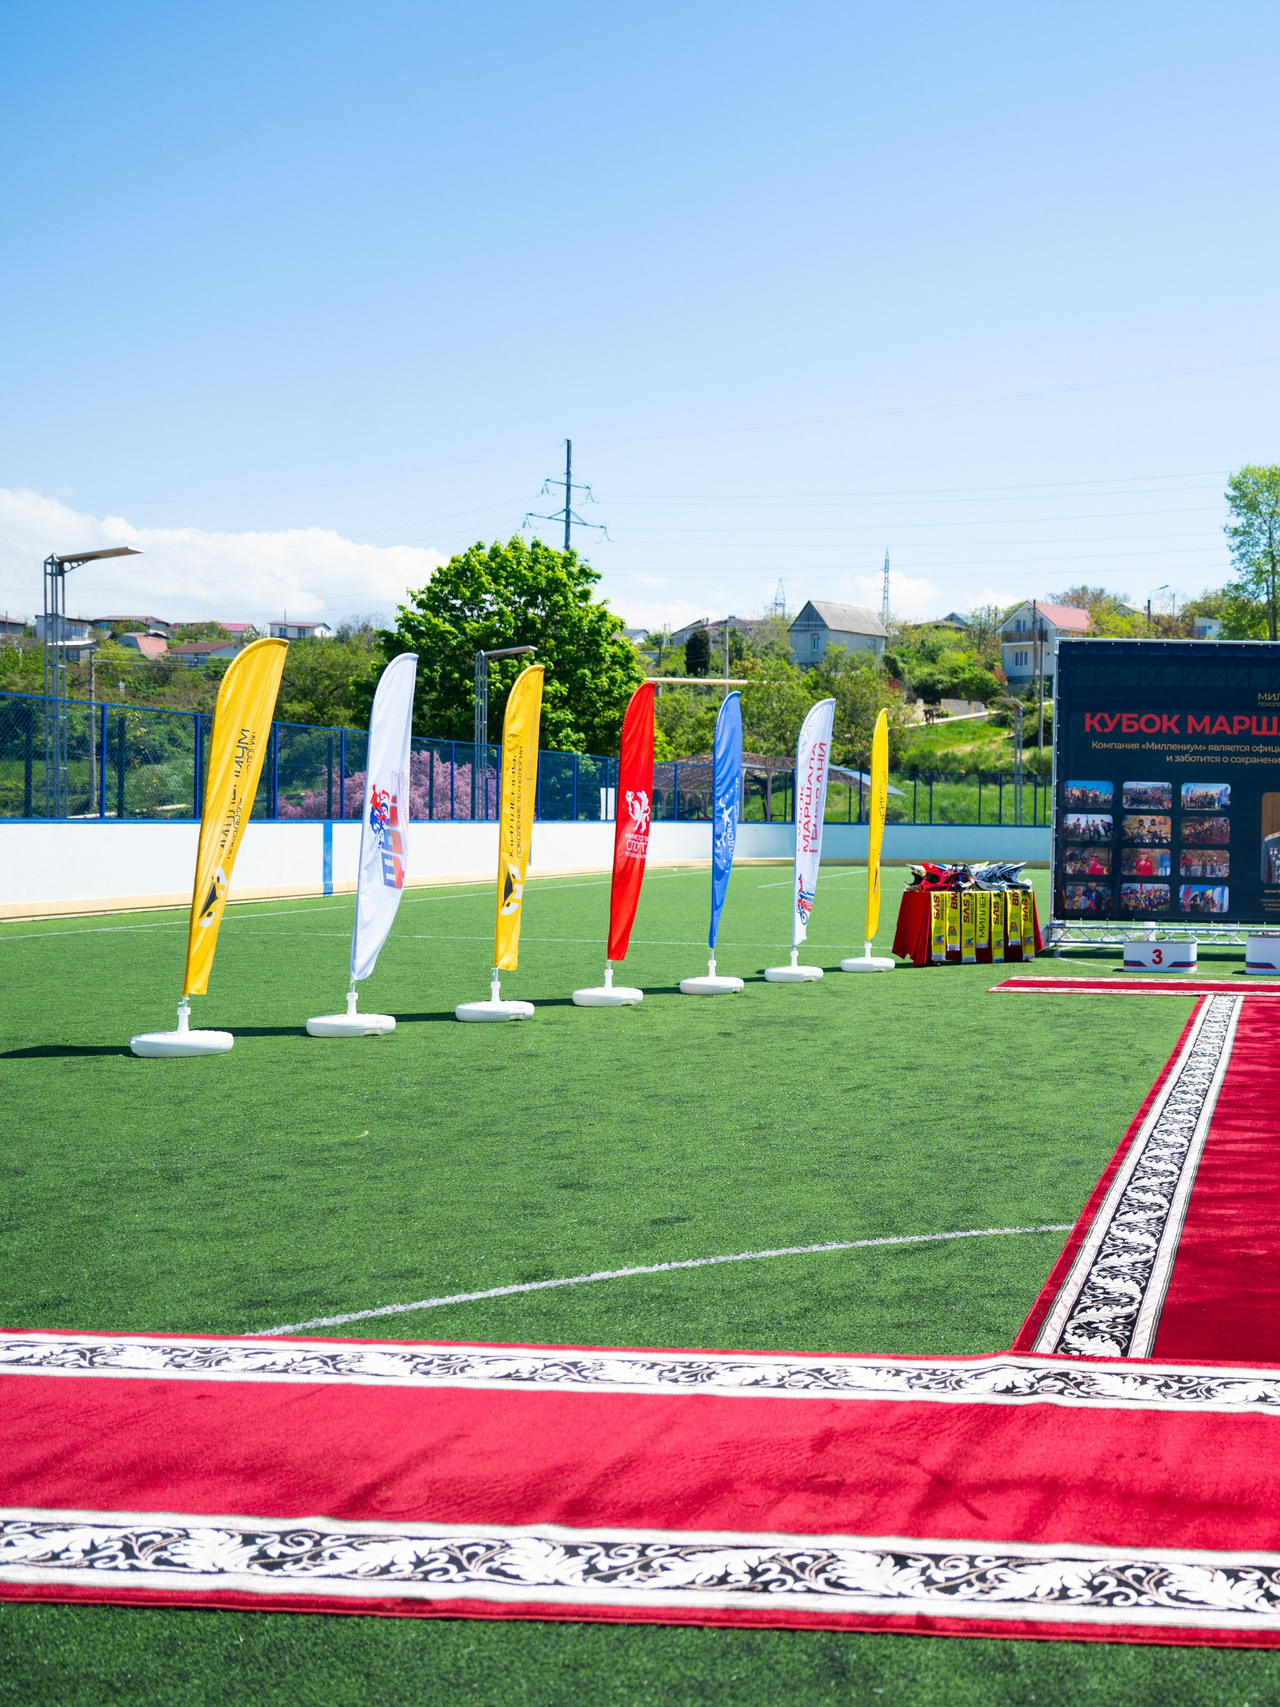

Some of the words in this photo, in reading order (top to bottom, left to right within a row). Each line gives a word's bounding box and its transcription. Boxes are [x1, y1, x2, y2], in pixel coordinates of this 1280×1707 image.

[1084, 712, 1181, 734] КУБОК
[1091, 740, 1140, 750] Компания
[1141, 742, 1206, 753] «Миллениум»
[1208, 744, 1250, 752] является
[1174, 753, 1221, 763] заботится
[1222, 755, 1229, 763] о
[803, 742, 818, 853] МАРШАЛА
[1151, 948, 1164, 965] 3
